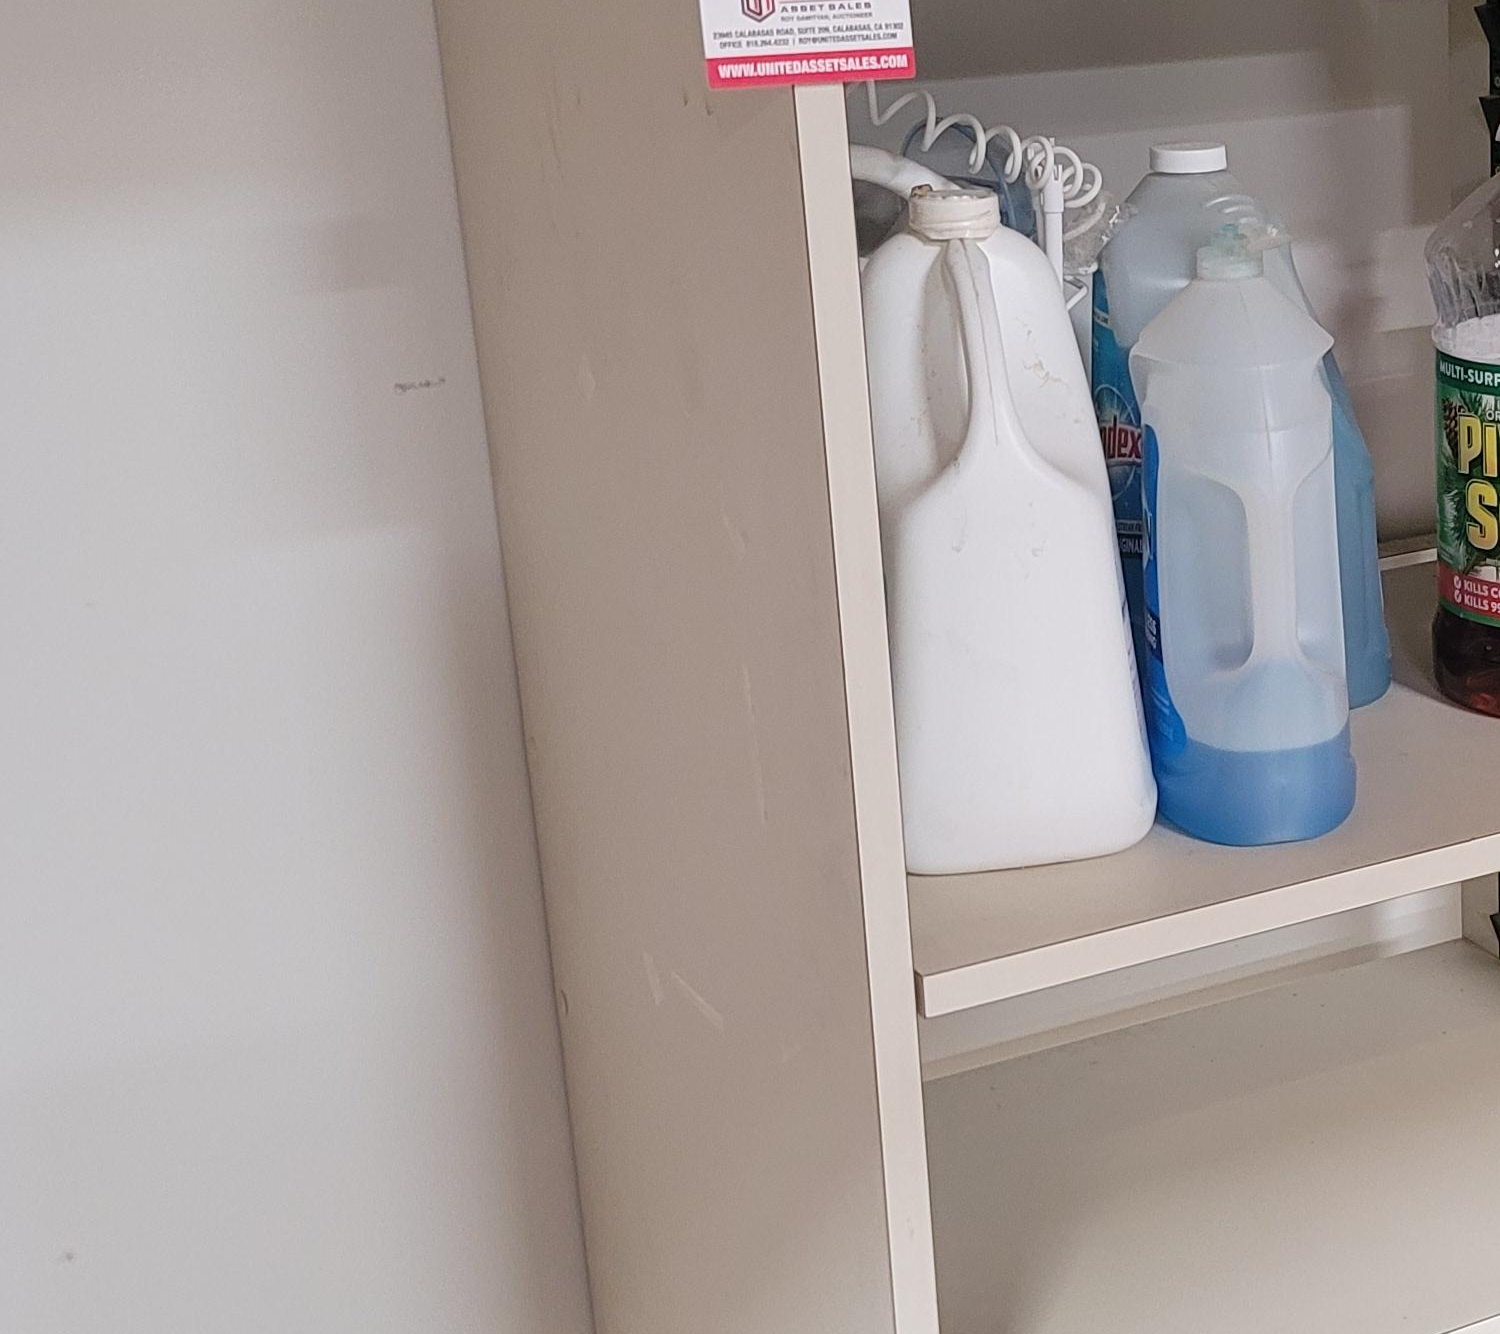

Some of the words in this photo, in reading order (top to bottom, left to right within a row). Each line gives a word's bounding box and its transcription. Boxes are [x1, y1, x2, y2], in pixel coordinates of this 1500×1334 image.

[781, 3, 824, 13] ASSET
[828, 1, 872, 10] SALES
[718, 54, 908, 78] WWW.UNITEDASSETSALES.COM
[1464, 580, 1488, 596] KILLS
[1464, 594, 1488, 611] KILLS
